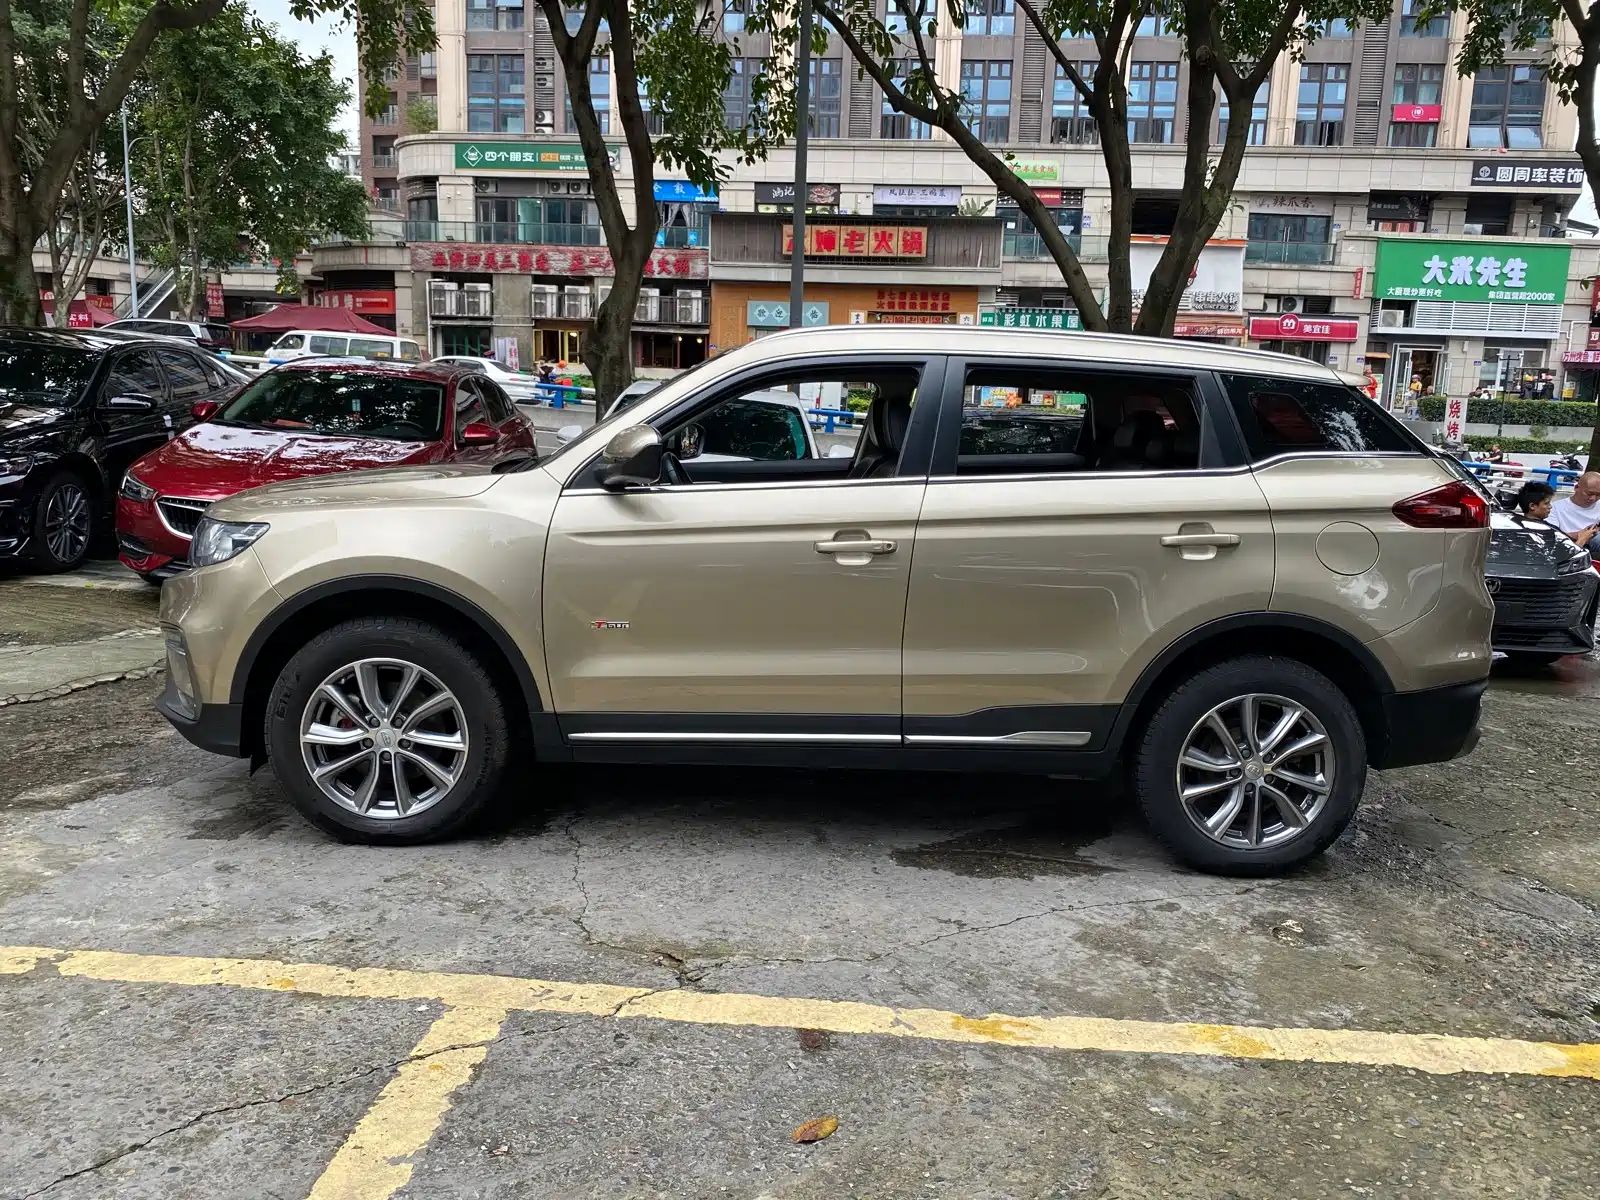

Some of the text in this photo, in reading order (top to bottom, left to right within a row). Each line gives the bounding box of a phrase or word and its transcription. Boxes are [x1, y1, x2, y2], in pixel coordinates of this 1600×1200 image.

[485, 151, 534, 162] 四个朋友
[1496, 166, 1585, 183] 圆周率装饰
[1421, 254, 1529, 289] 大米先生
[1194, 291, 1240, 304] 串串火锅
[1488, 290, 1556, 301] 集团直营超2000家
[1003, 313, 1079, 328] 彩虹水果屋
[1303, 323, 1331, 335] 美宜佳
[1446, 399, 1462, 440] 烧烤
